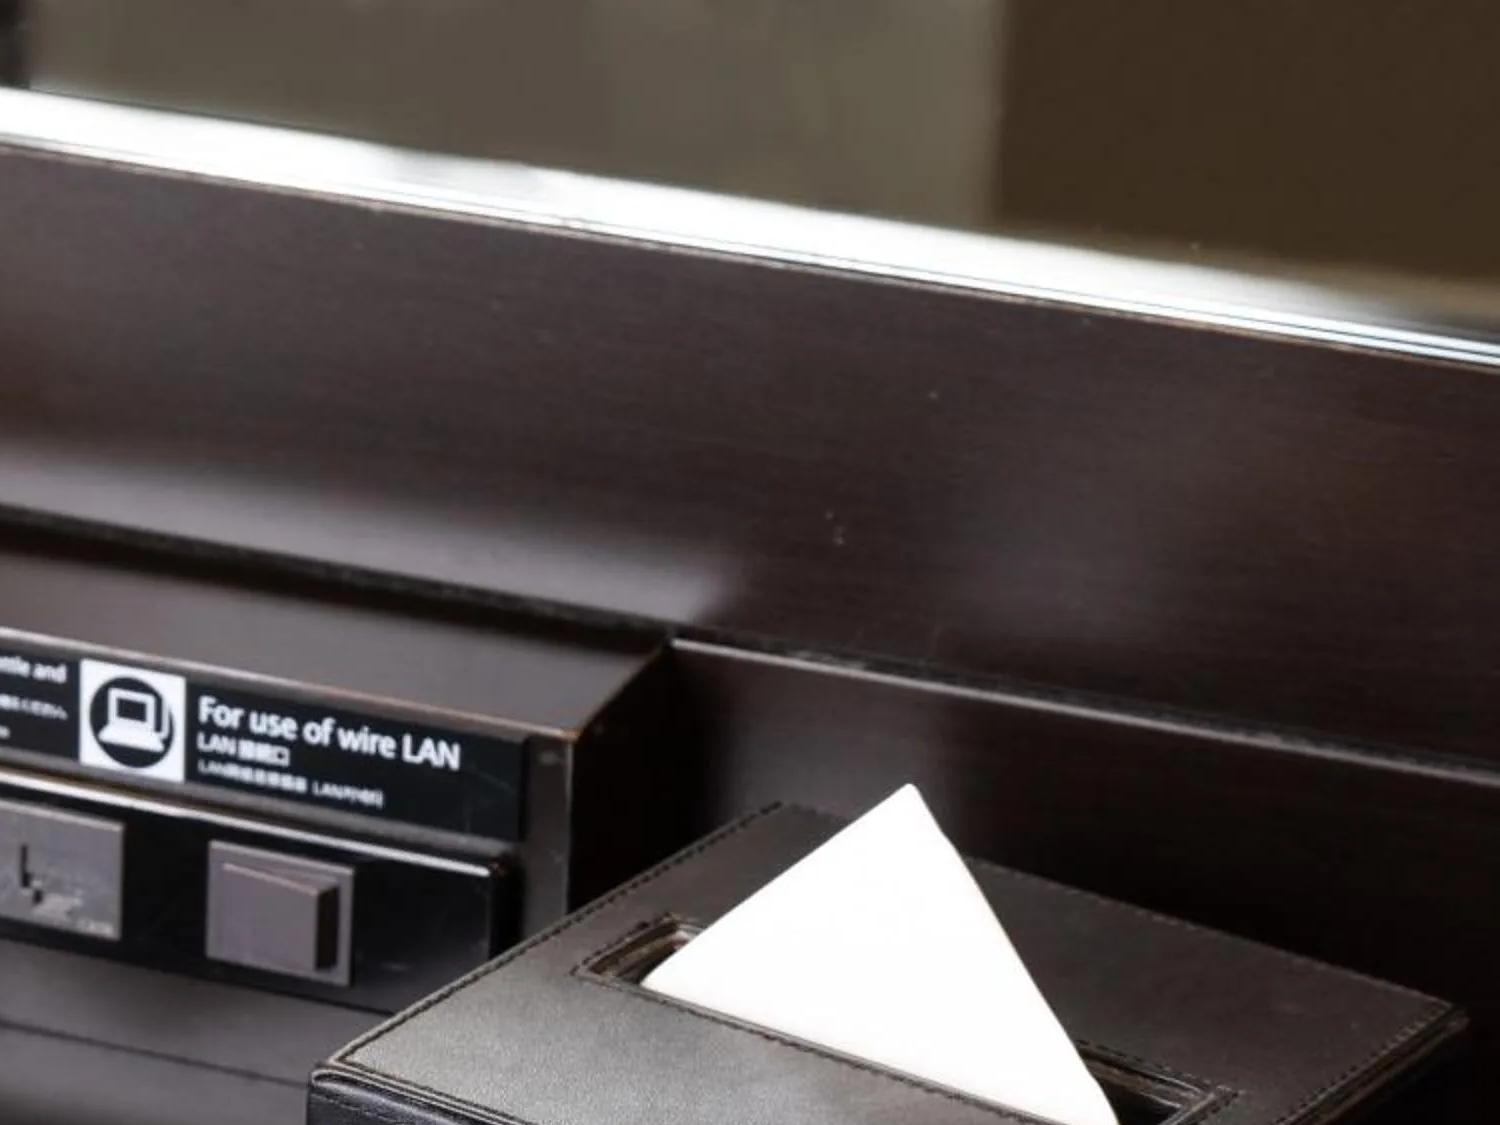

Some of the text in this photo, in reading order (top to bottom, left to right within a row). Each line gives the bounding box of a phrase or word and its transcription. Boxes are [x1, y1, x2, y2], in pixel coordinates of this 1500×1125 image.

[33, 663, 67, 684] and
[199, 696, 461, 772] For use of wire LAN
